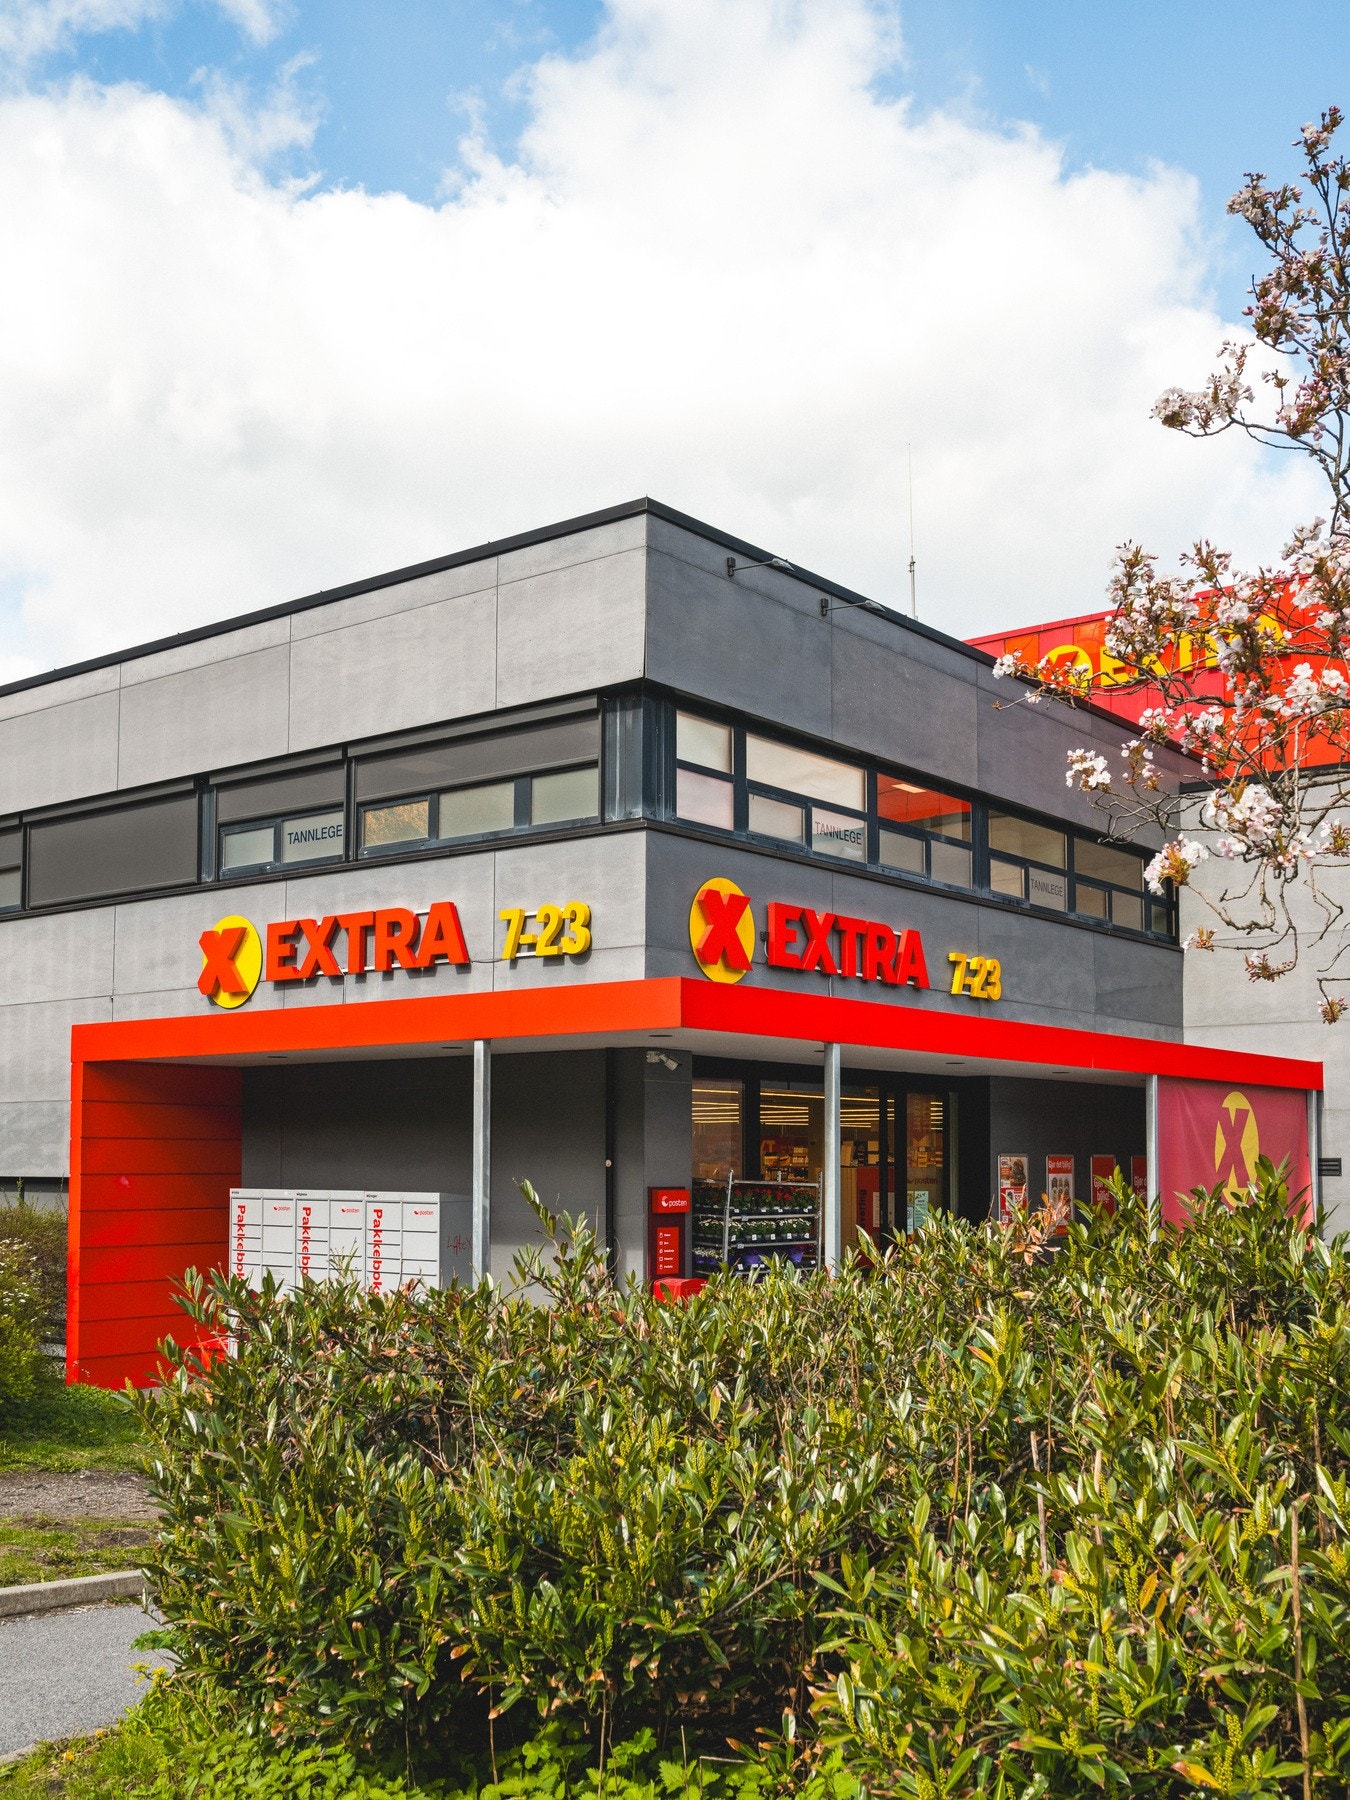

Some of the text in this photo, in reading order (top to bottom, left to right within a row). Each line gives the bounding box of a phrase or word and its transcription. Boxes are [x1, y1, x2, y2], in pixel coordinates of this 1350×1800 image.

[287, 824, 343, 845] TANNLEGE
[814, 821, 862, 845] TANNLEGE
[1030, 878, 1063, 897] TANNLEGE
[198, 902, 591, 995] X EXTRA 7-23
[695, 889, 1002, 1001] X EXTRA 7-23
[668, 1200, 687, 1208] posten
[237, 1205, 246, 1280] Pakkebok
[302, 1207, 311, 1276] Pakkebo
